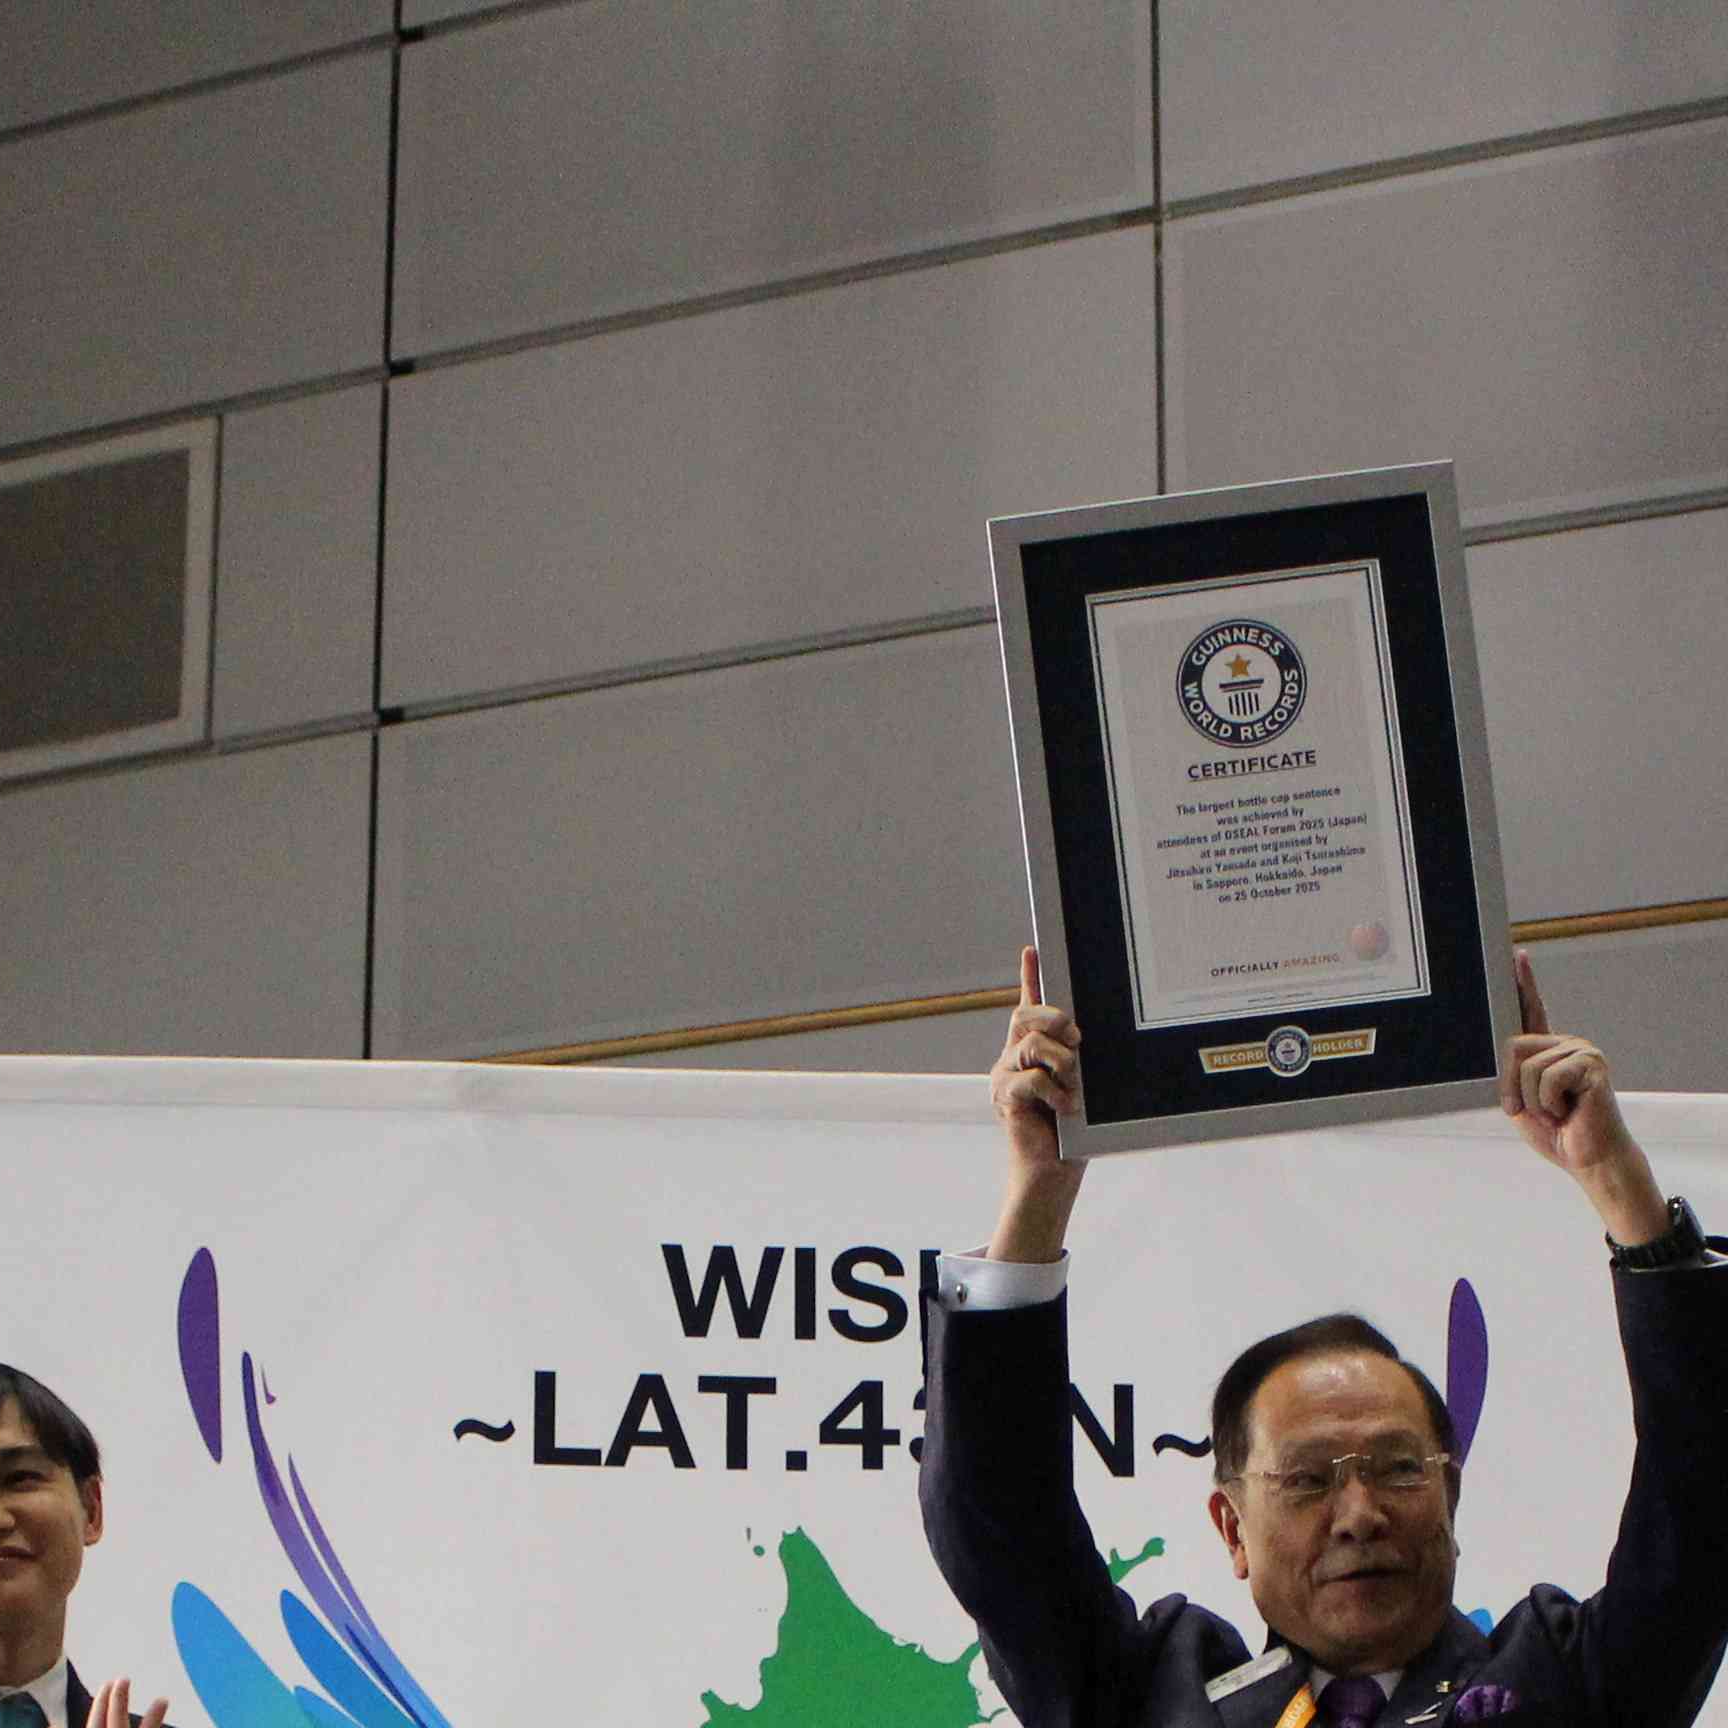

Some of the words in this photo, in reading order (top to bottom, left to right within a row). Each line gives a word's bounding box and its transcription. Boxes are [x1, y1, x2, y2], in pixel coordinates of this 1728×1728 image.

[1192, 627, 1284, 666] GUINNESS
[1184, 681, 1232, 737] WORLD
[1240, 669, 1298, 740] RECORDS
[1187, 750, 1316, 779] CERTIFICATE
[1176, 804, 1196, 816] The
[1199, 801, 1235, 814] largest
[1238, 796, 1266, 808] bottle
[1271, 794, 1290, 804] cap
[1293, 788, 1341, 800] sentence
[1216, 816, 1239, 826] was
[1243, 808, 1289, 822] achieved
[1291, 806, 1304, 817] by
[1157, 834, 1208, 849] attendees
[1211, 831, 1221, 842] of
[1225, 826, 1261, 840] OSEAL
[1263, 823, 1296, 835] Forum
[1300, 818, 1325, 831] 2025
[1328, 812, 1367, 828] (Japan)
[1200, 848, 1211, 859] at
[1214, 848, 1226, 857] an
[1229, 843, 1258, 855] event
[1315, 833, 1328, 846] by
[1216, 859, 1256, 872] Yamada
[1260, 855, 1279, 866] and
[1193, 880, 1203, 891] in
[1310, 864, 1342, 876] Japan
[1218, 895, 1231, 903] on
[1234, 891, 1248, 901] 25
[1251, 886, 1291, 898] October
[1295, 881, 1320, 893] 2025
[1211, 961, 1279, 977] OFFICIALLY
[1213, 1050, 1264, 1065] RECORD
[1312, 1039, 1363, 1053] HOLDER
[661, 1243, 940, 1343] WIS
